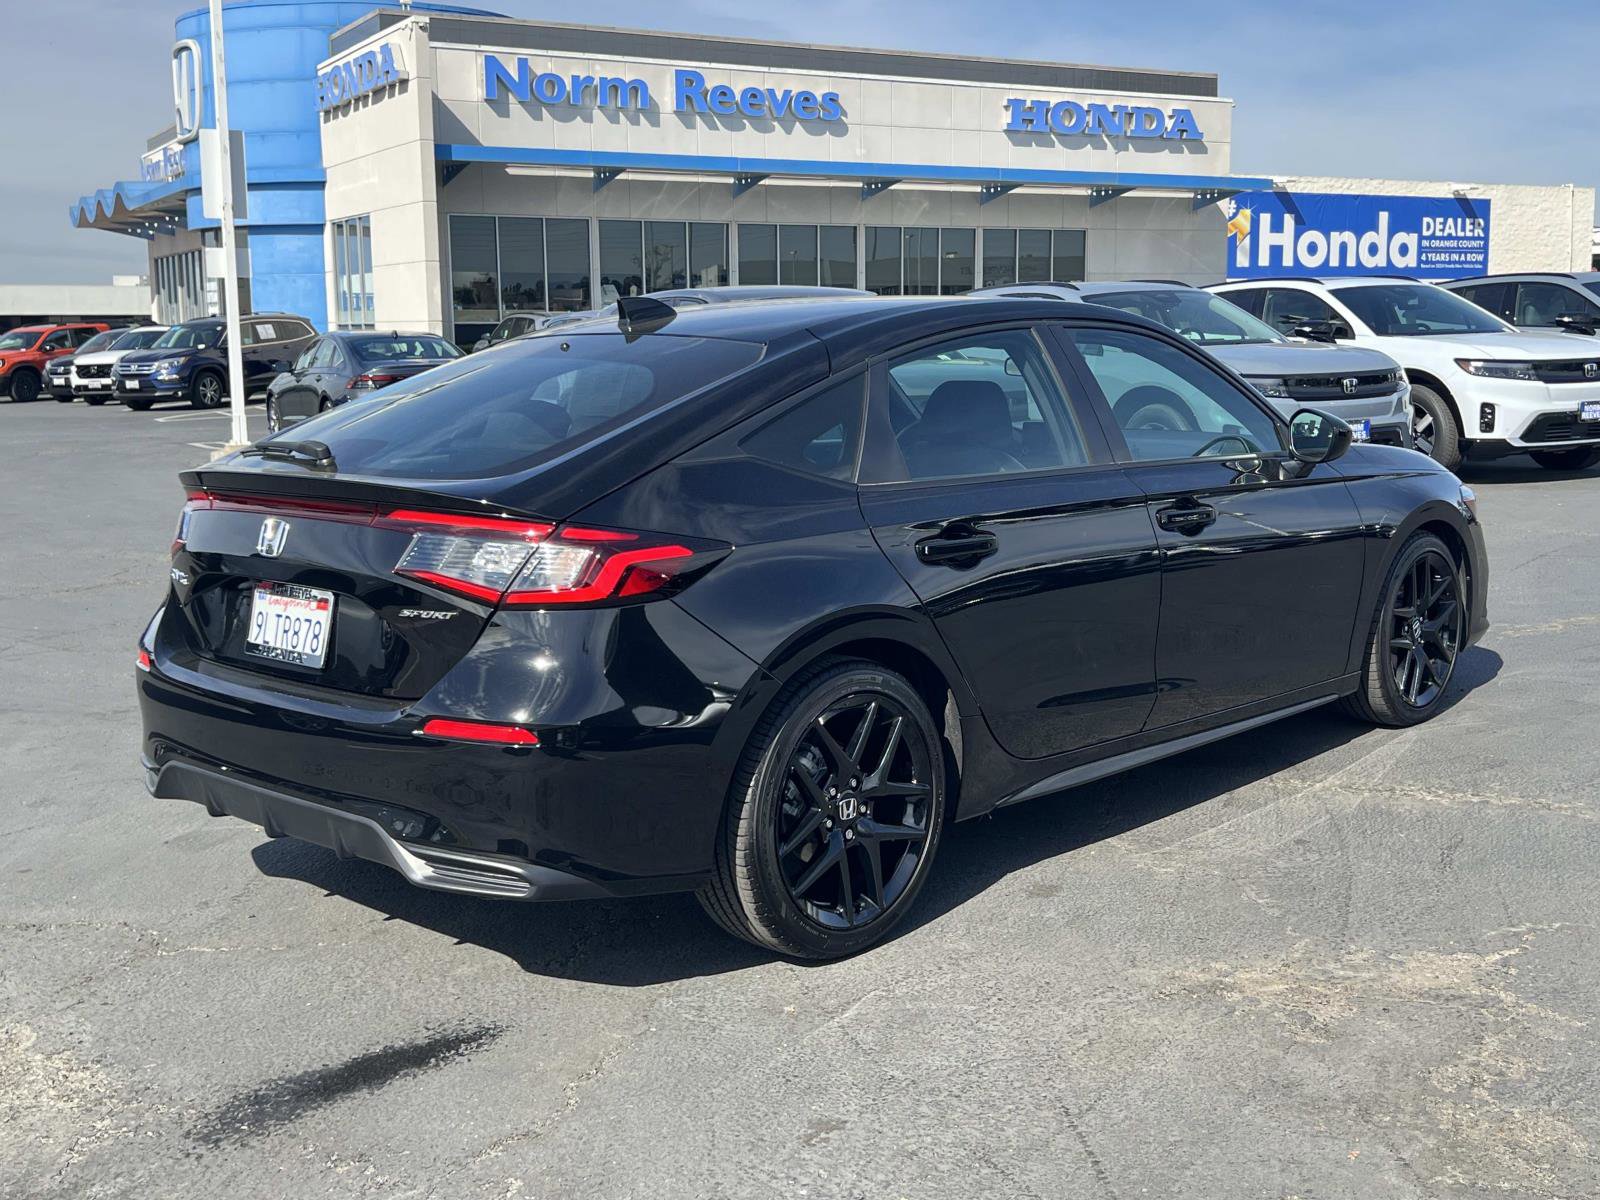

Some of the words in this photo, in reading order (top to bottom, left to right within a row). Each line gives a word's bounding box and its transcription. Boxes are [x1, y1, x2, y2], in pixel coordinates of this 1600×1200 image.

[313, 43, 401, 112] HONDA
[484, 54, 649, 109] Norm
[674, 69, 841, 121] Reeves
[1004, 98, 1204, 140] HONDA
[1257, 211, 1419, 268] Honda
[1421, 239, 1430, 247] IN
[1430, 240, 1458, 248] ORANGE
[1458, 240, 1485, 248] COUNTY
[1422, 217, 1485, 237] DEALER
[1420, 253, 1426, 261] 4
[1427, 253, 1450, 262] YEARS
[1450, 253, 1459, 262] IN
[1460, 253, 1466, 262] A
[1466, 253, 1485, 262] ROW
[253, 611, 322, 653] 9LTR878
[398, 609, 458, 620] SPORT
